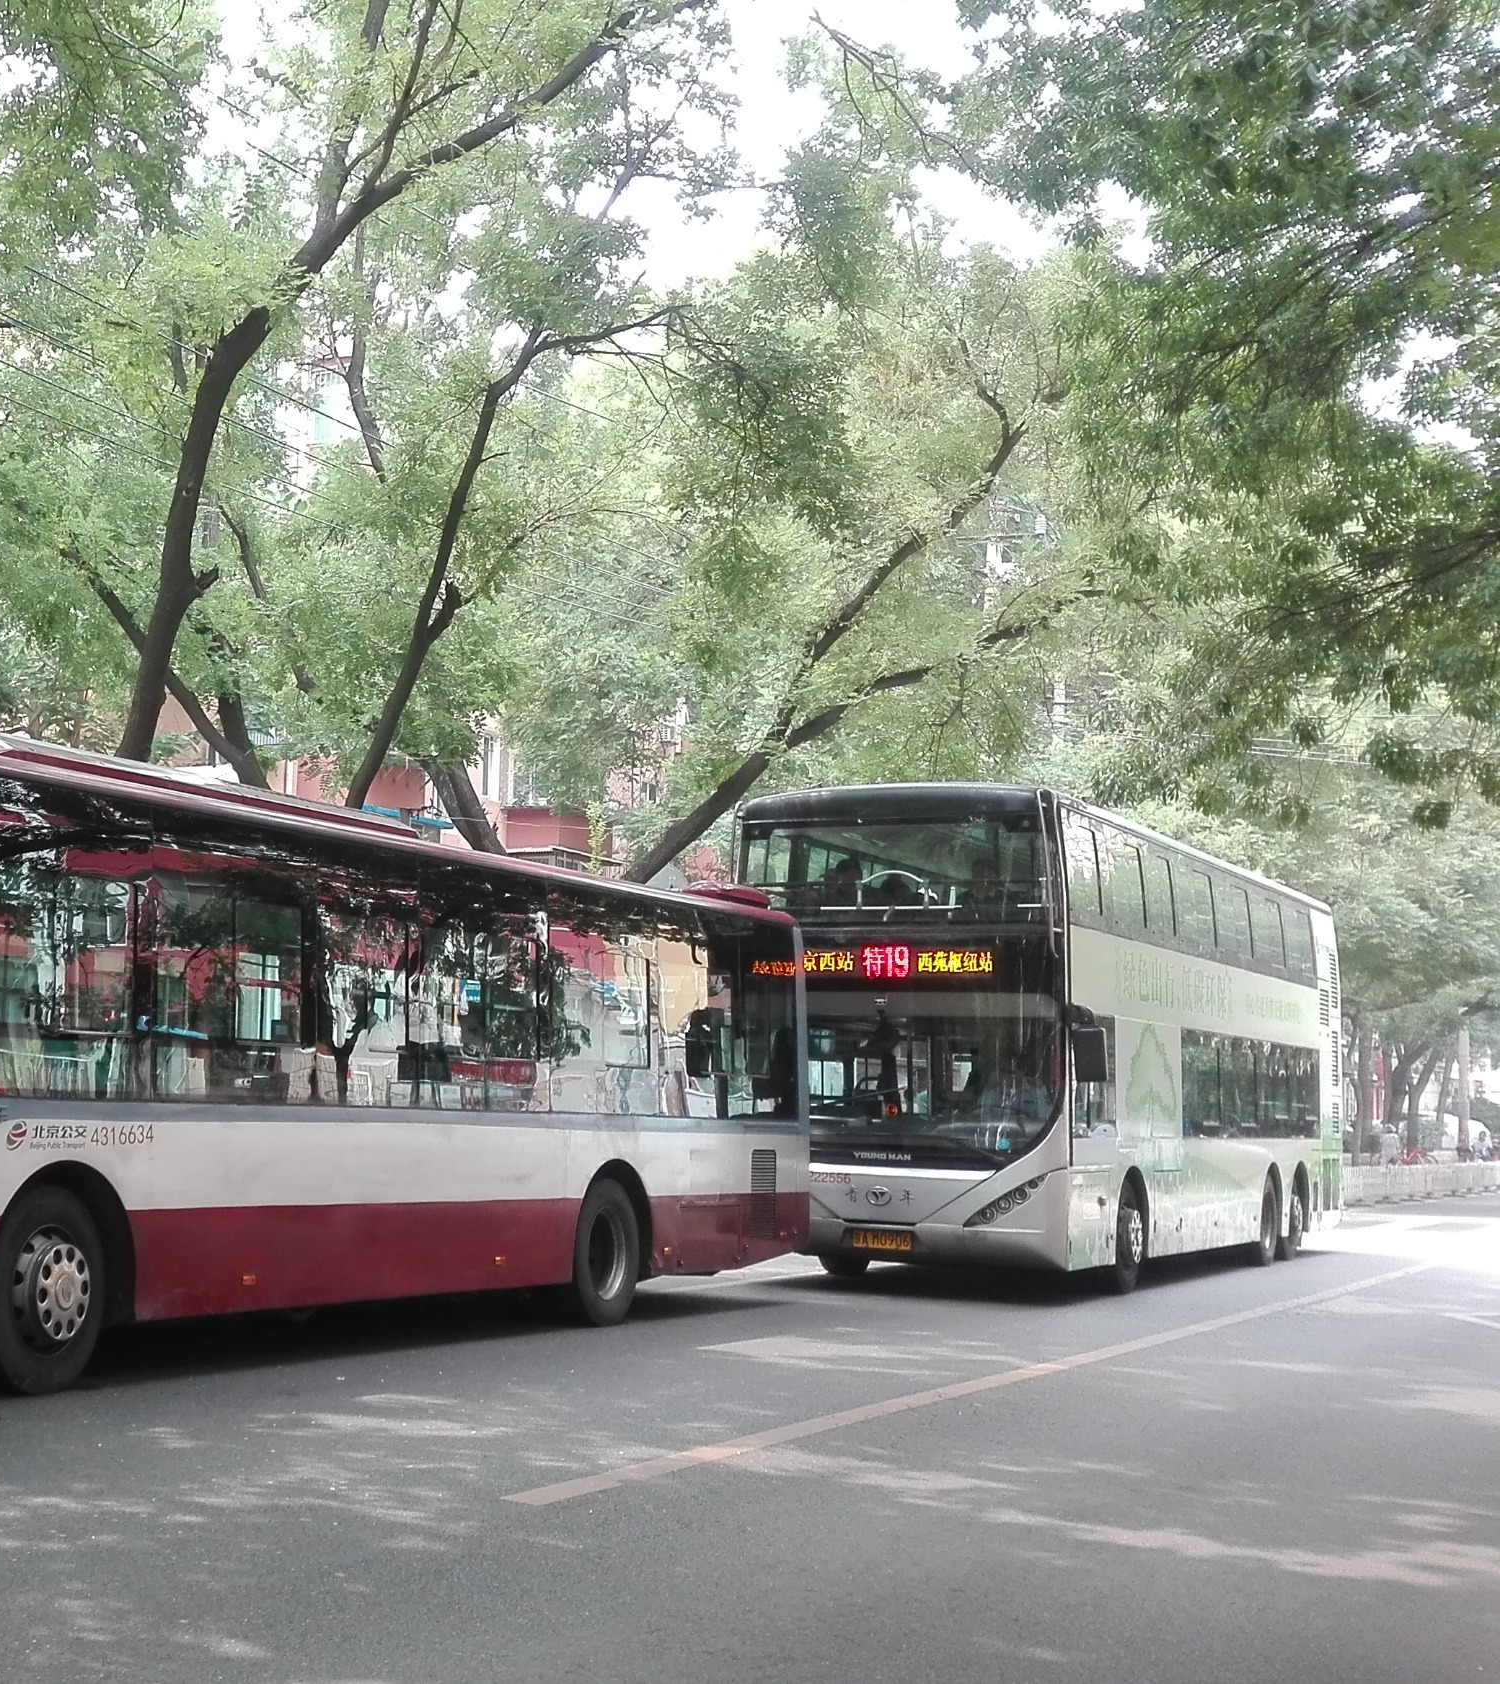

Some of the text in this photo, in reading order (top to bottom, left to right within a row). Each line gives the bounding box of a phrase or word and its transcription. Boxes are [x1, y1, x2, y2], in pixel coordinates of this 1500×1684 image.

[863, 946, 909, 977] 特19
[917, 951, 993, 973] 西苑枢纽站
[29, 1141, 86, 1151] Beijing Public Transport
[31, 1124, 154, 1146] 北京公交 4316634
[853, 1151, 887, 1160] YOUNG
